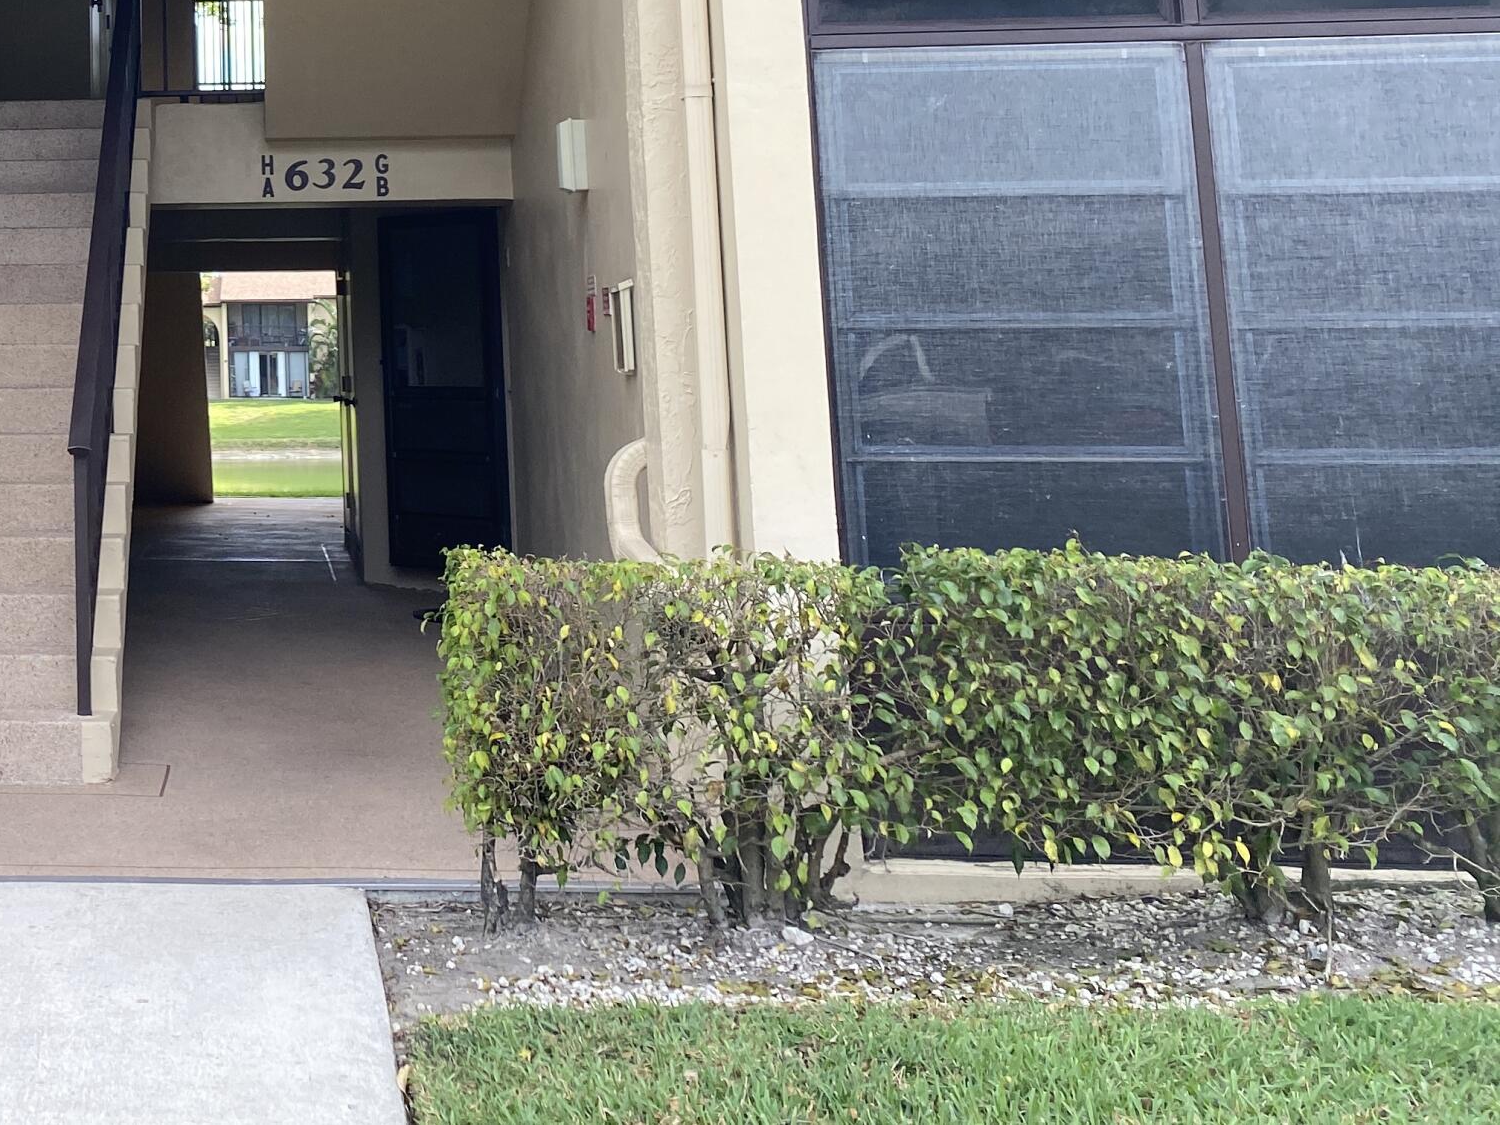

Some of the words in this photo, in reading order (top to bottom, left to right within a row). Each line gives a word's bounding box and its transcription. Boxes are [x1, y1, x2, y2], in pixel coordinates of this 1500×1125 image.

[261, 155, 274, 175] H
[375, 154, 389, 174] G
[285, 158, 366, 191] 632
[262, 178, 275, 198] A
[376, 176, 389, 197] B
